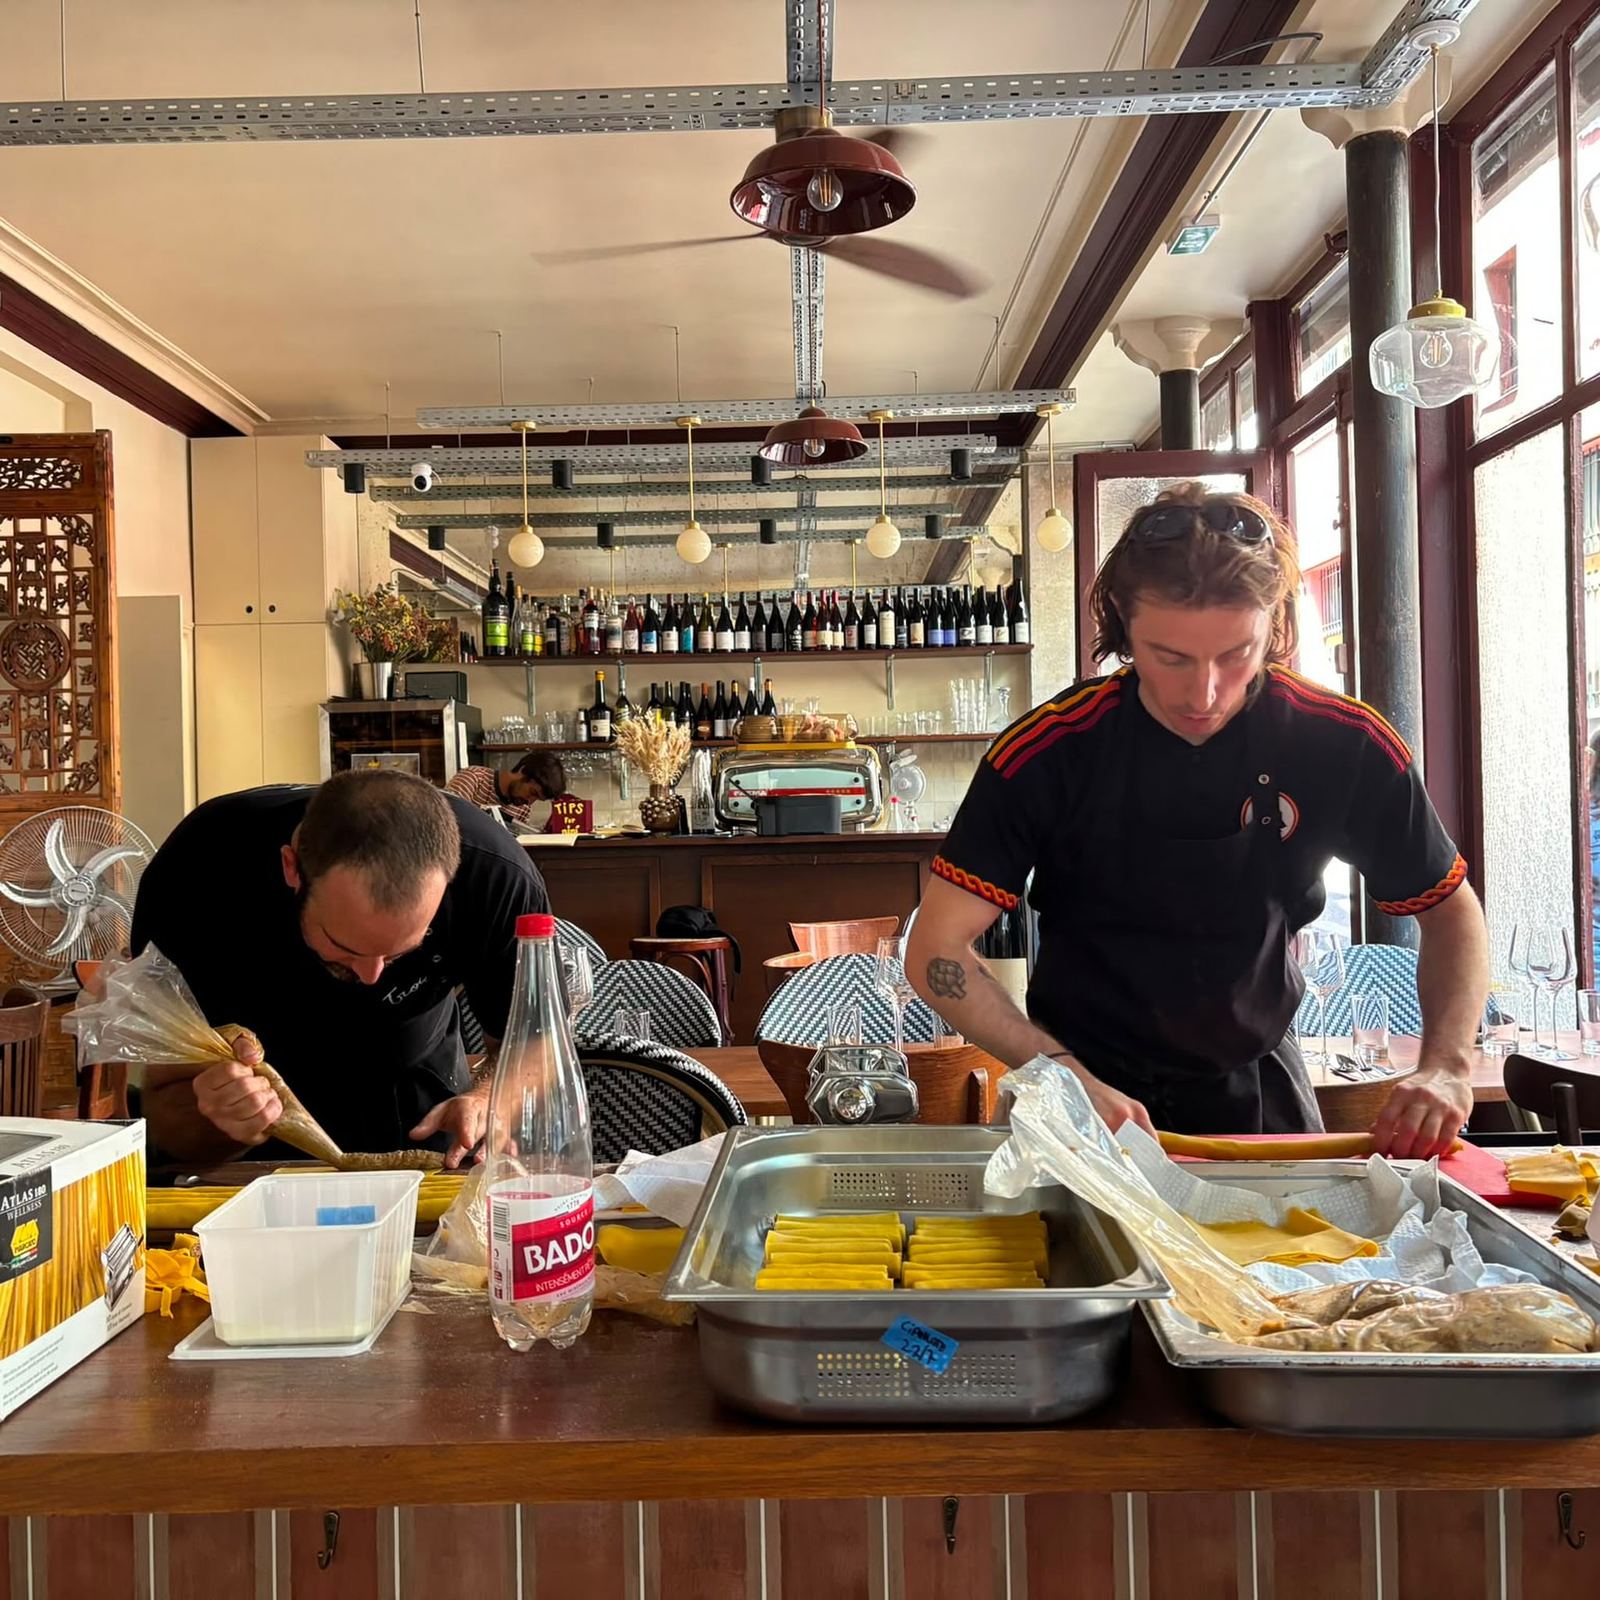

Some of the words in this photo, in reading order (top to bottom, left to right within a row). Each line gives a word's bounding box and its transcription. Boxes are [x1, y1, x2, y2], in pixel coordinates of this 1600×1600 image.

[1, 1187, 34, 1211] ATLAS
[34, 1184, 47, 1198] 180
[7, 1199, 42, 1220] WELLNESS
